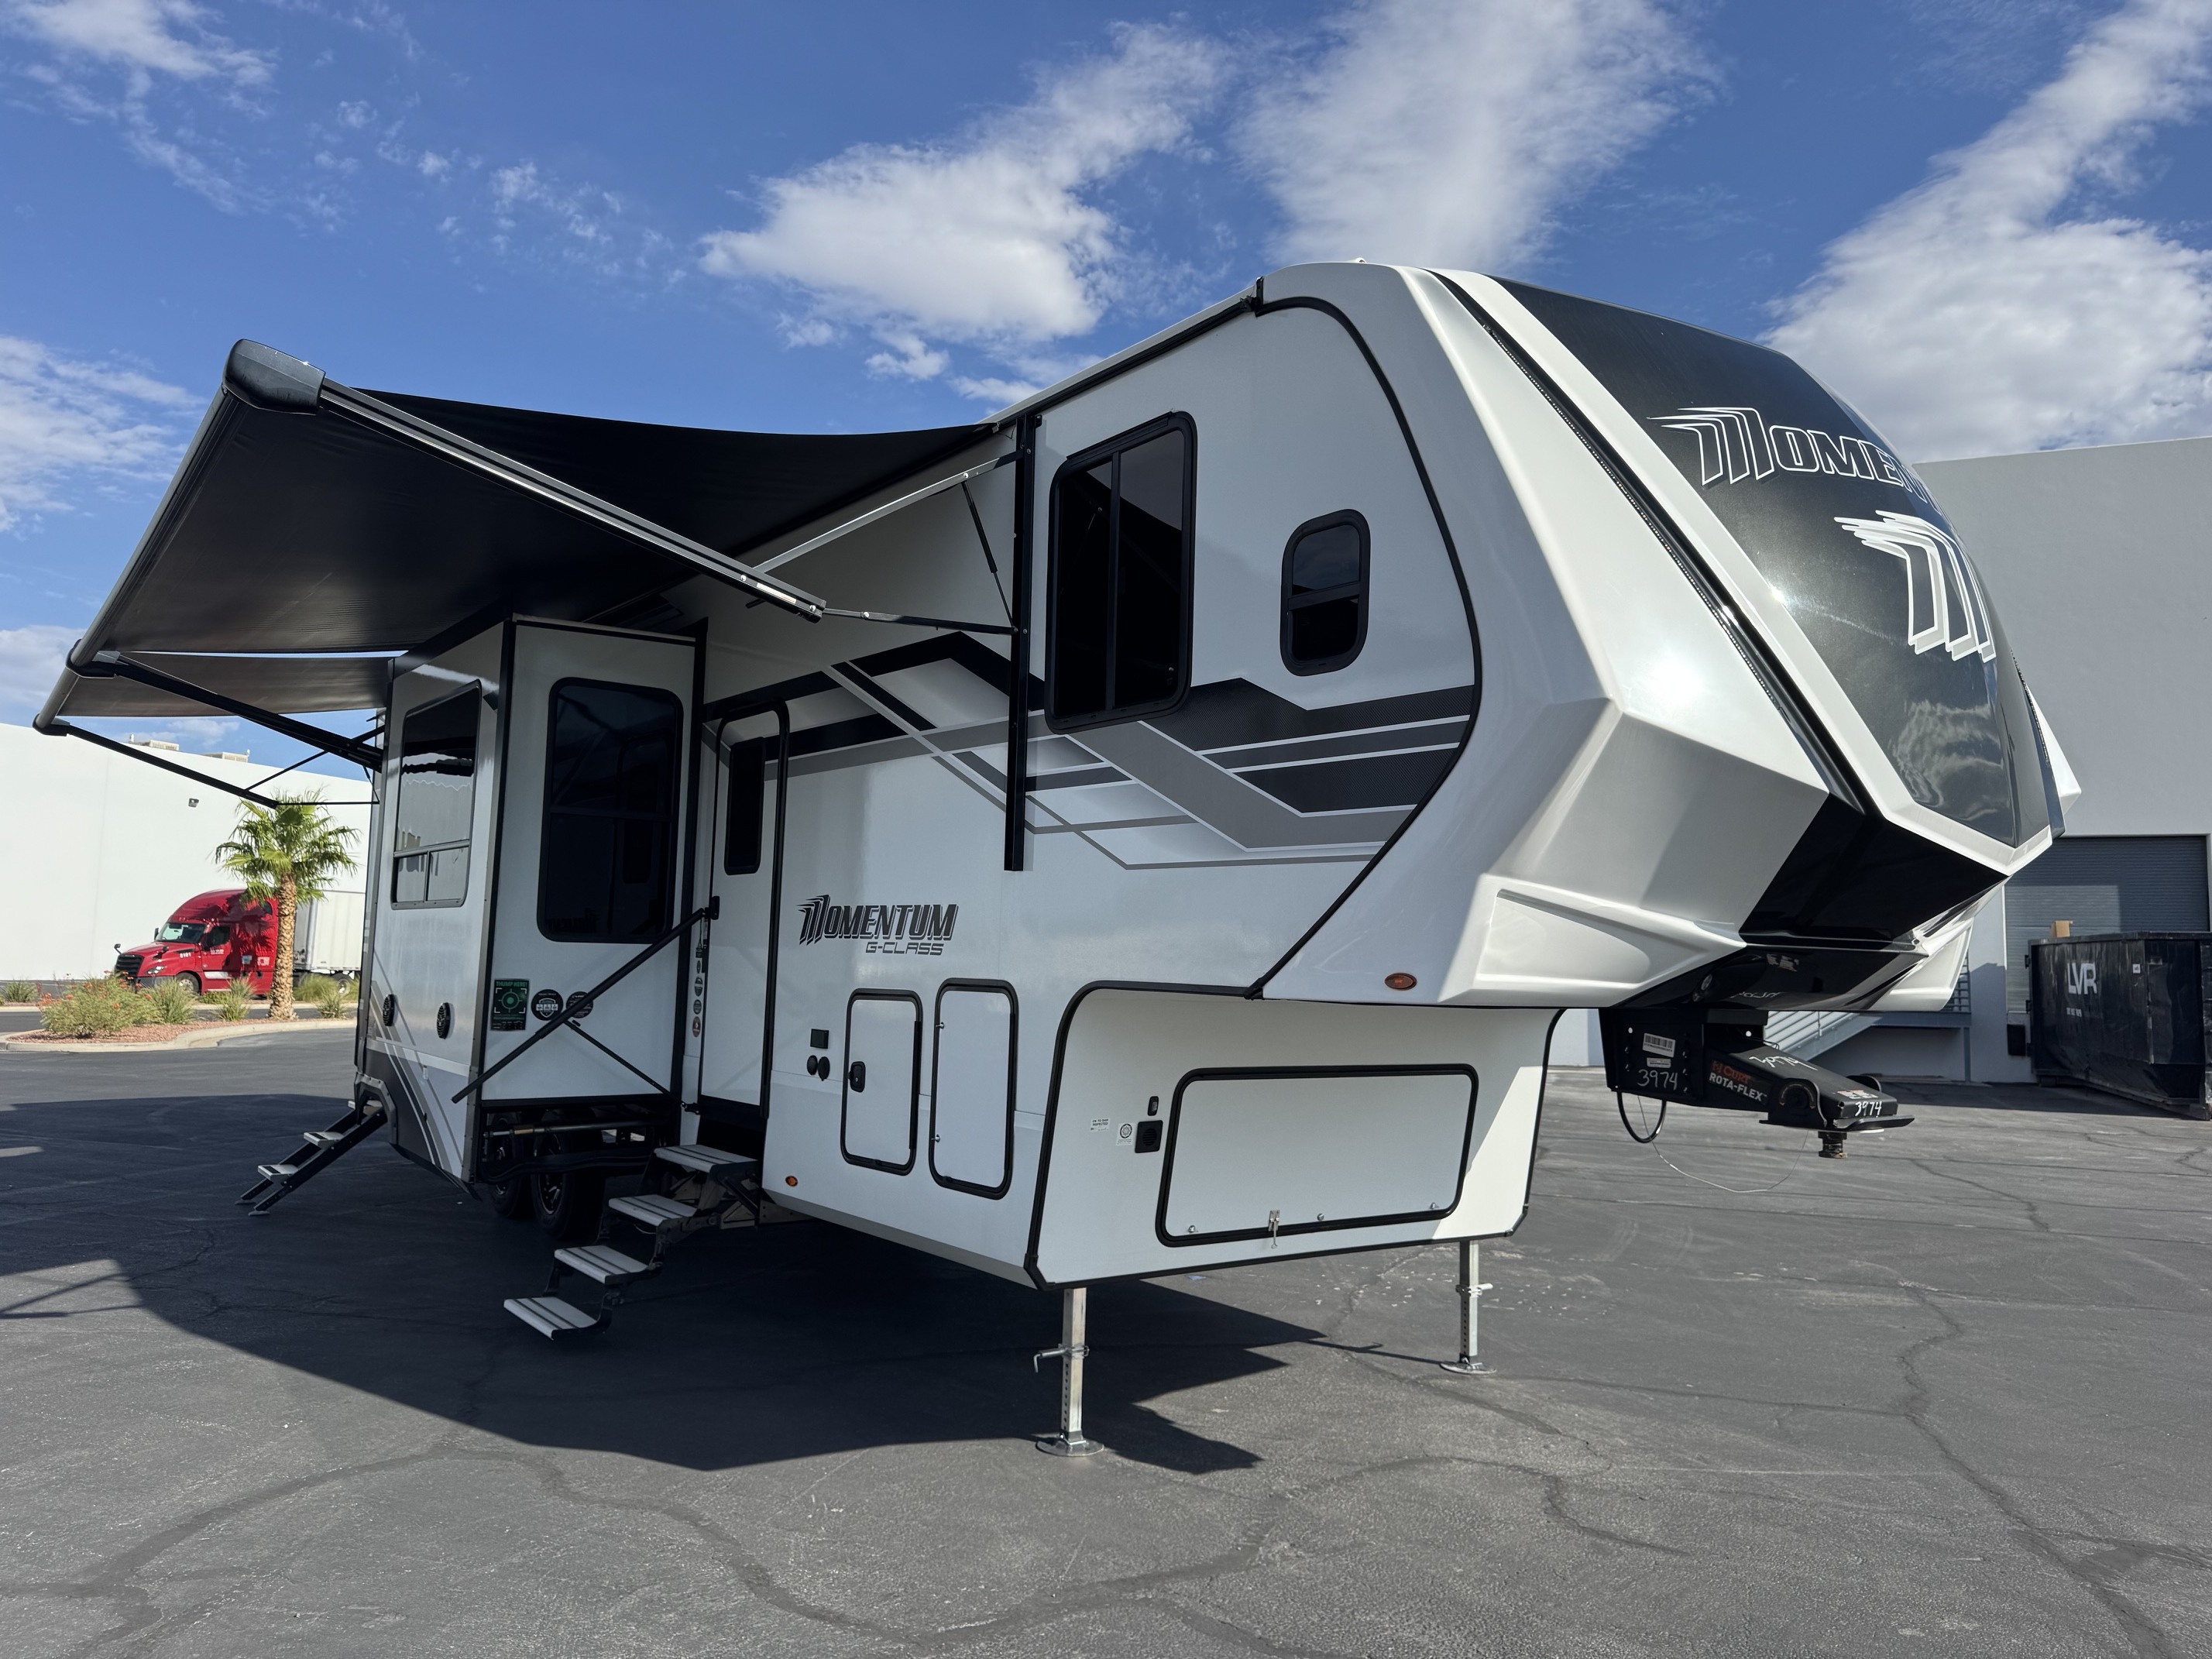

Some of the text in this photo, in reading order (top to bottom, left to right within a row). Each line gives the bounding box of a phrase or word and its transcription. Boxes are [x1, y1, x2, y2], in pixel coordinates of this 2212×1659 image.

[796, 895, 959, 946] MOMENTUM
[865, 941, 944, 956] G-CLASS
[2067, 962, 2097, 995] LVR
[1637, 1069, 1678, 1091] 3974
[1854, 1101, 1883, 1118] 3974
